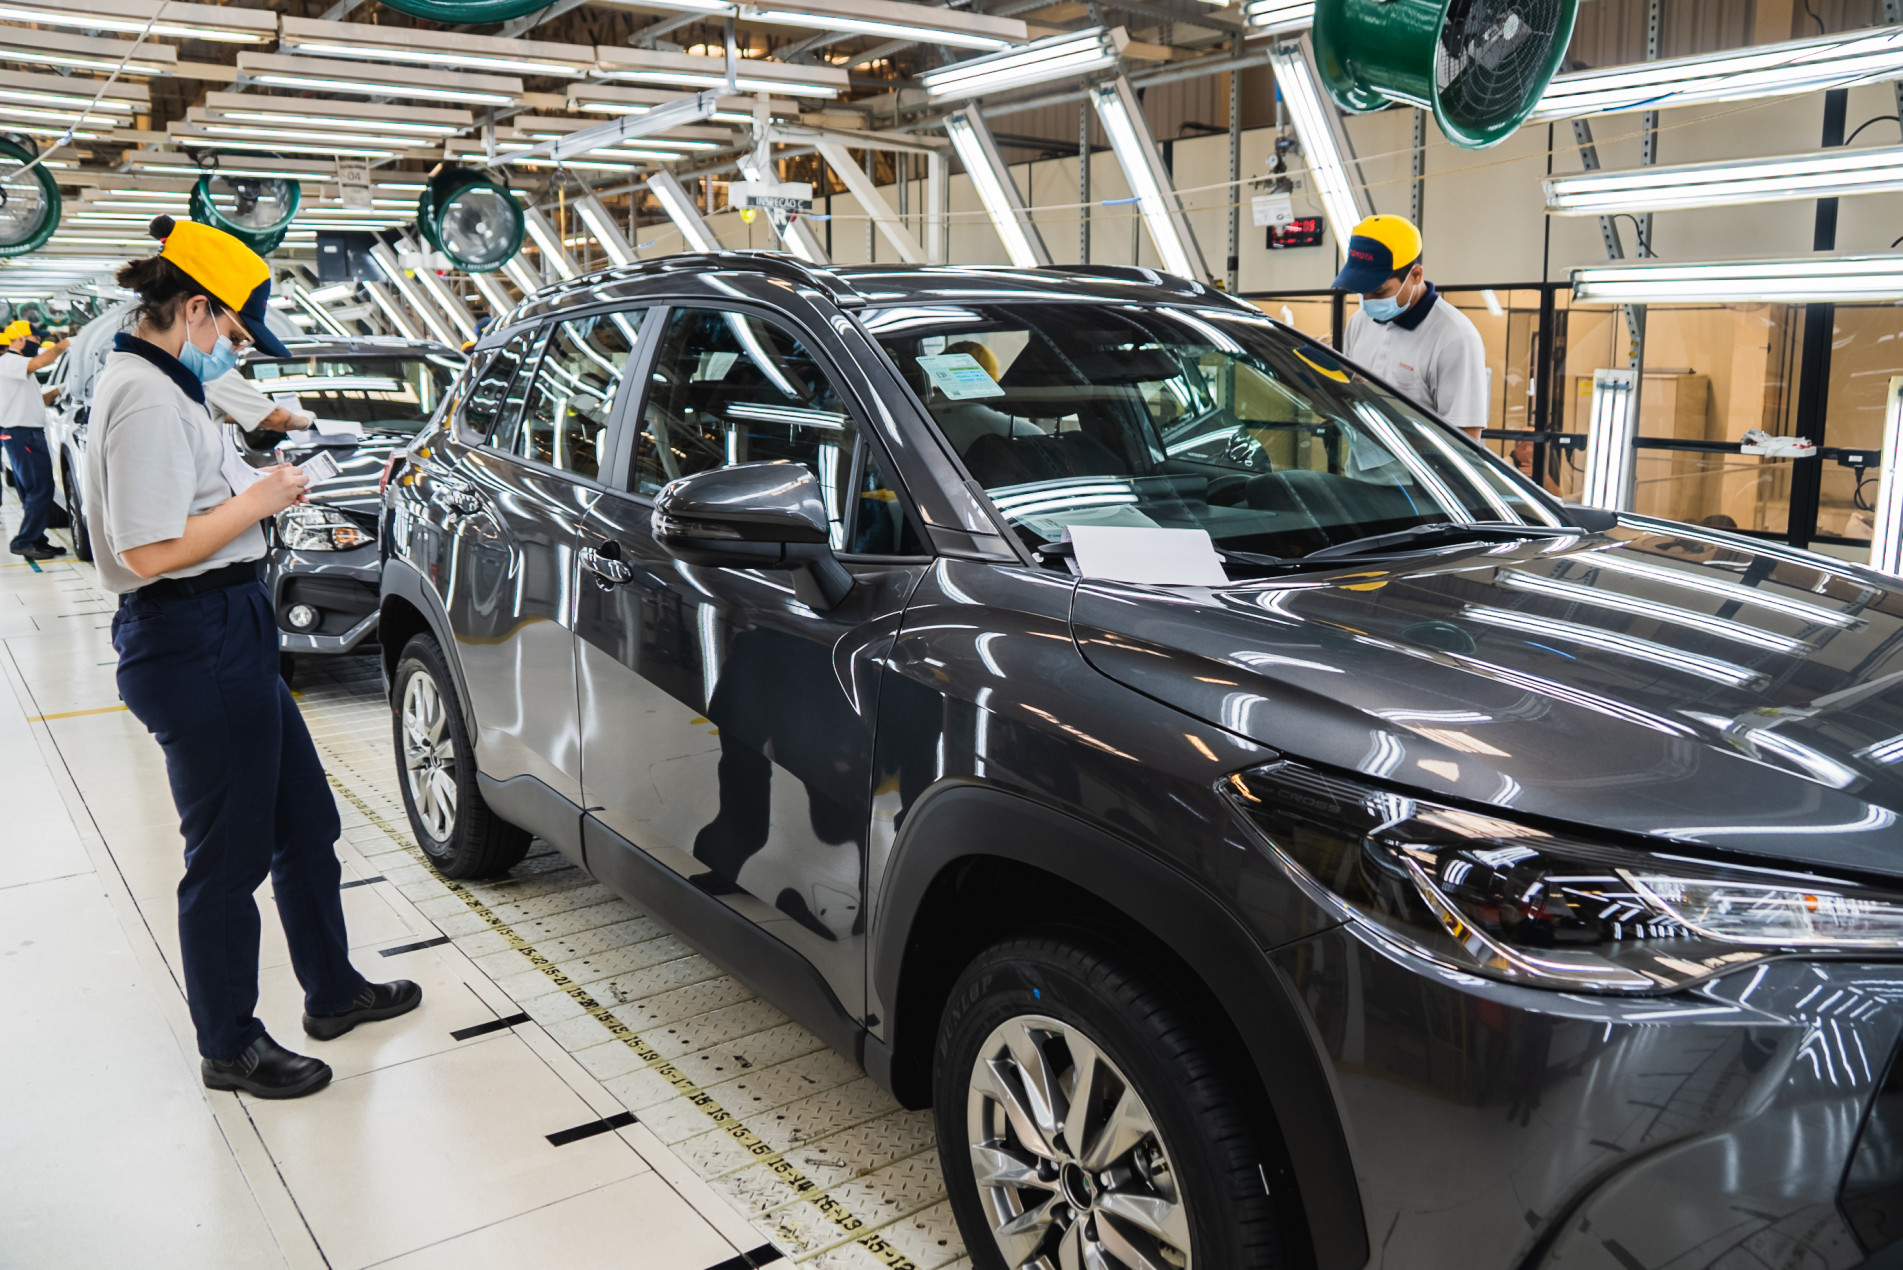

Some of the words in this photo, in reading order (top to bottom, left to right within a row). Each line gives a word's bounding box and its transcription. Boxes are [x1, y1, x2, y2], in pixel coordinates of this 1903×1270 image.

[1349, 249, 1374, 261] TOYOTA
[541, 966, 572, 986] 15-21
[941, 974, 992, 1059] DUNLOP
[726, 1123, 773, 1155] 15-15
[811, 1194, 863, 1231] 15-13
